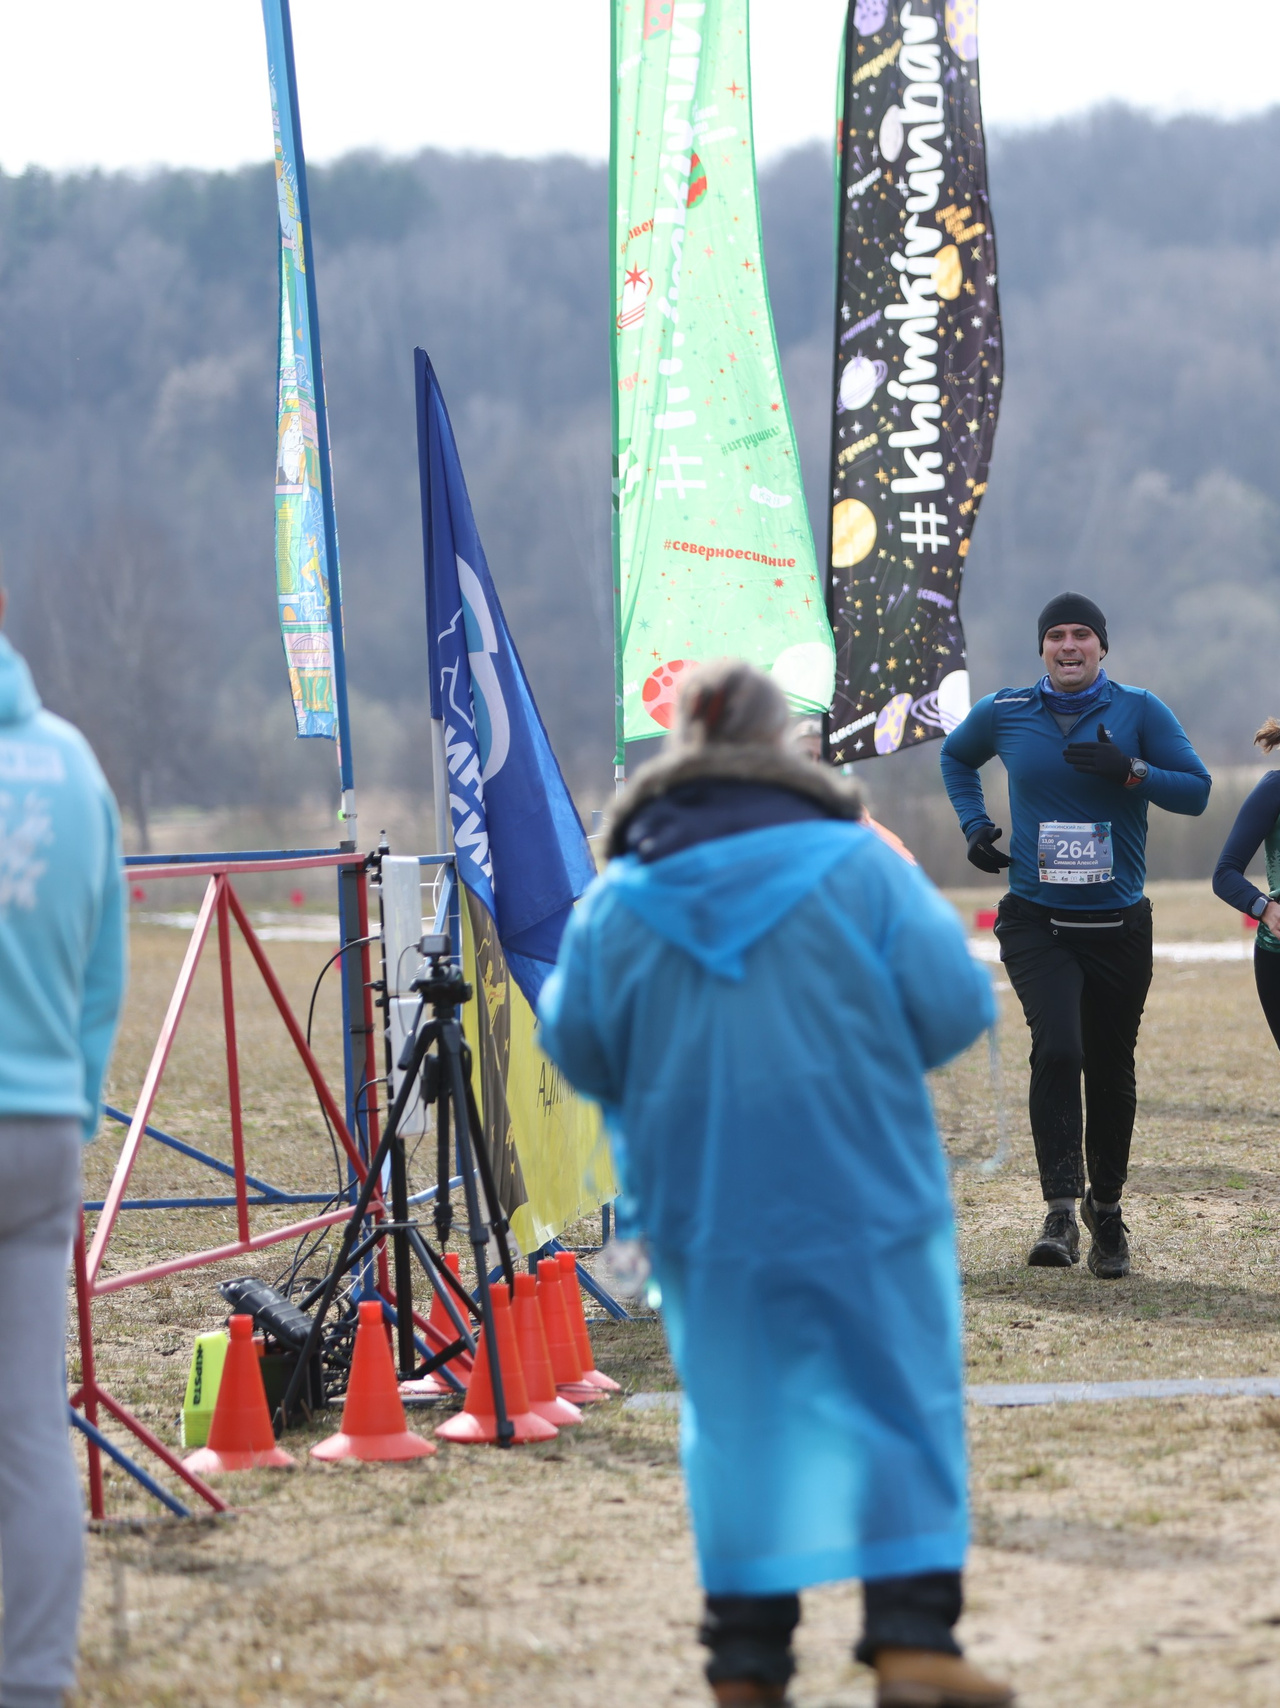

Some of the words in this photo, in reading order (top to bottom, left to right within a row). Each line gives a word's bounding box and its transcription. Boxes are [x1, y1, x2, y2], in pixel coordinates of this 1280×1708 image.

[883, 1, 950, 554] #khimkirunbar
[663, 538, 797, 568] #северноесияние
[1057, 840, 1095, 858] 264
